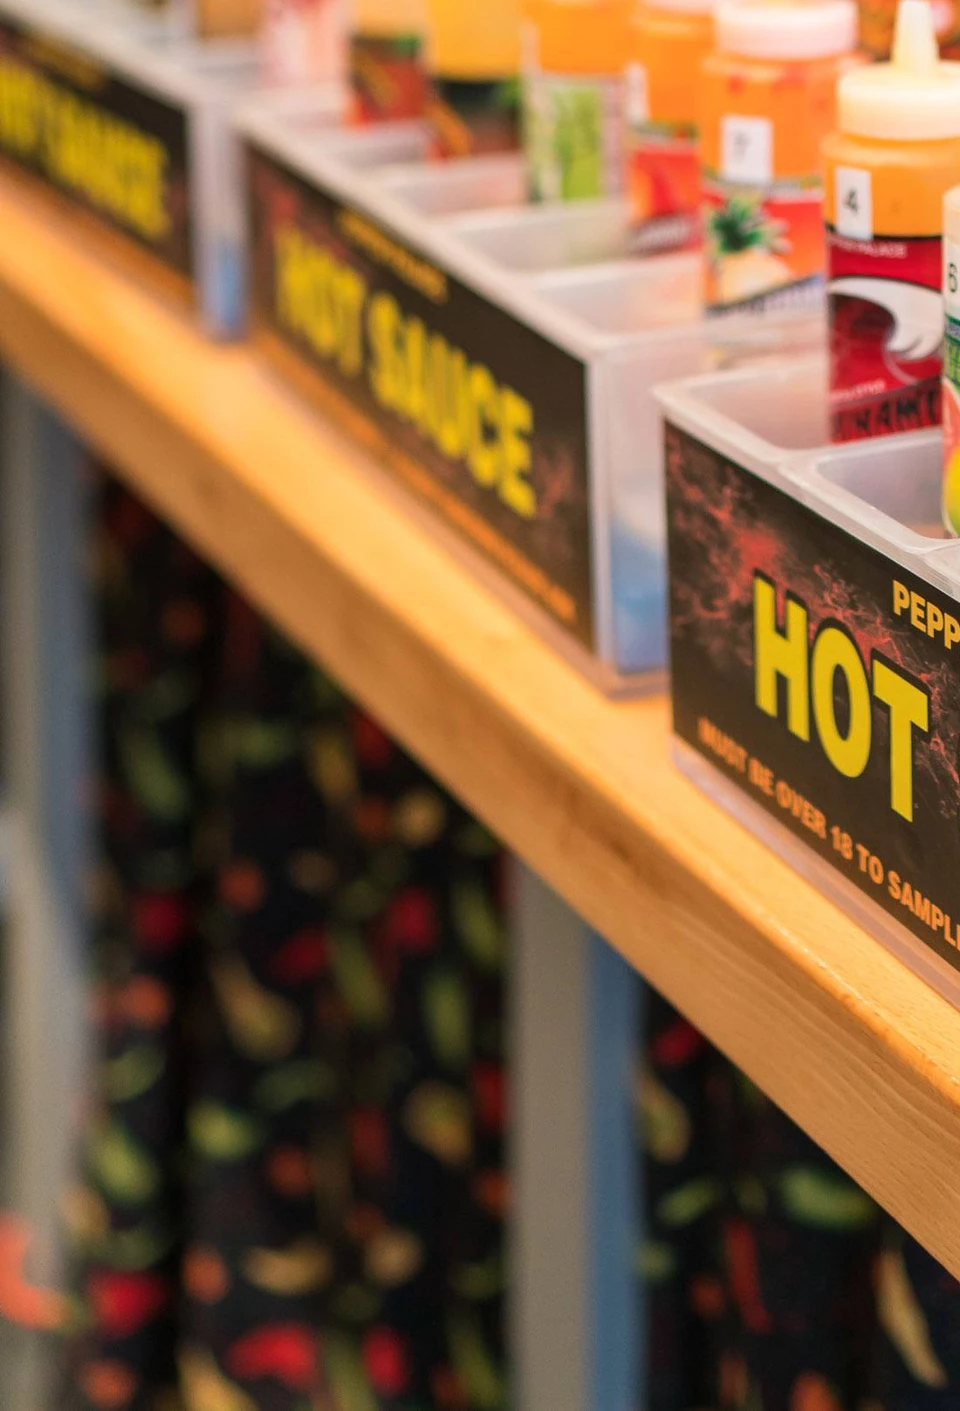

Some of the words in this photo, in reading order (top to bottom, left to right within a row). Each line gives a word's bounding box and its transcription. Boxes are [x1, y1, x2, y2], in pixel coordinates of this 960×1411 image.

[842, 188, 860, 214] 4
[275, 226, 365, 377] HOT
[369, 292, 537, 518] SAUCE
[699, 717, 748, 766] MUST
[747, 758, 774, 796] BE
[775, 780, 828, 843] OVER
[832, 825, 854, 860] 18
[856, 844, 884, 886] TO
[754, 577, 928, 823] HOT
